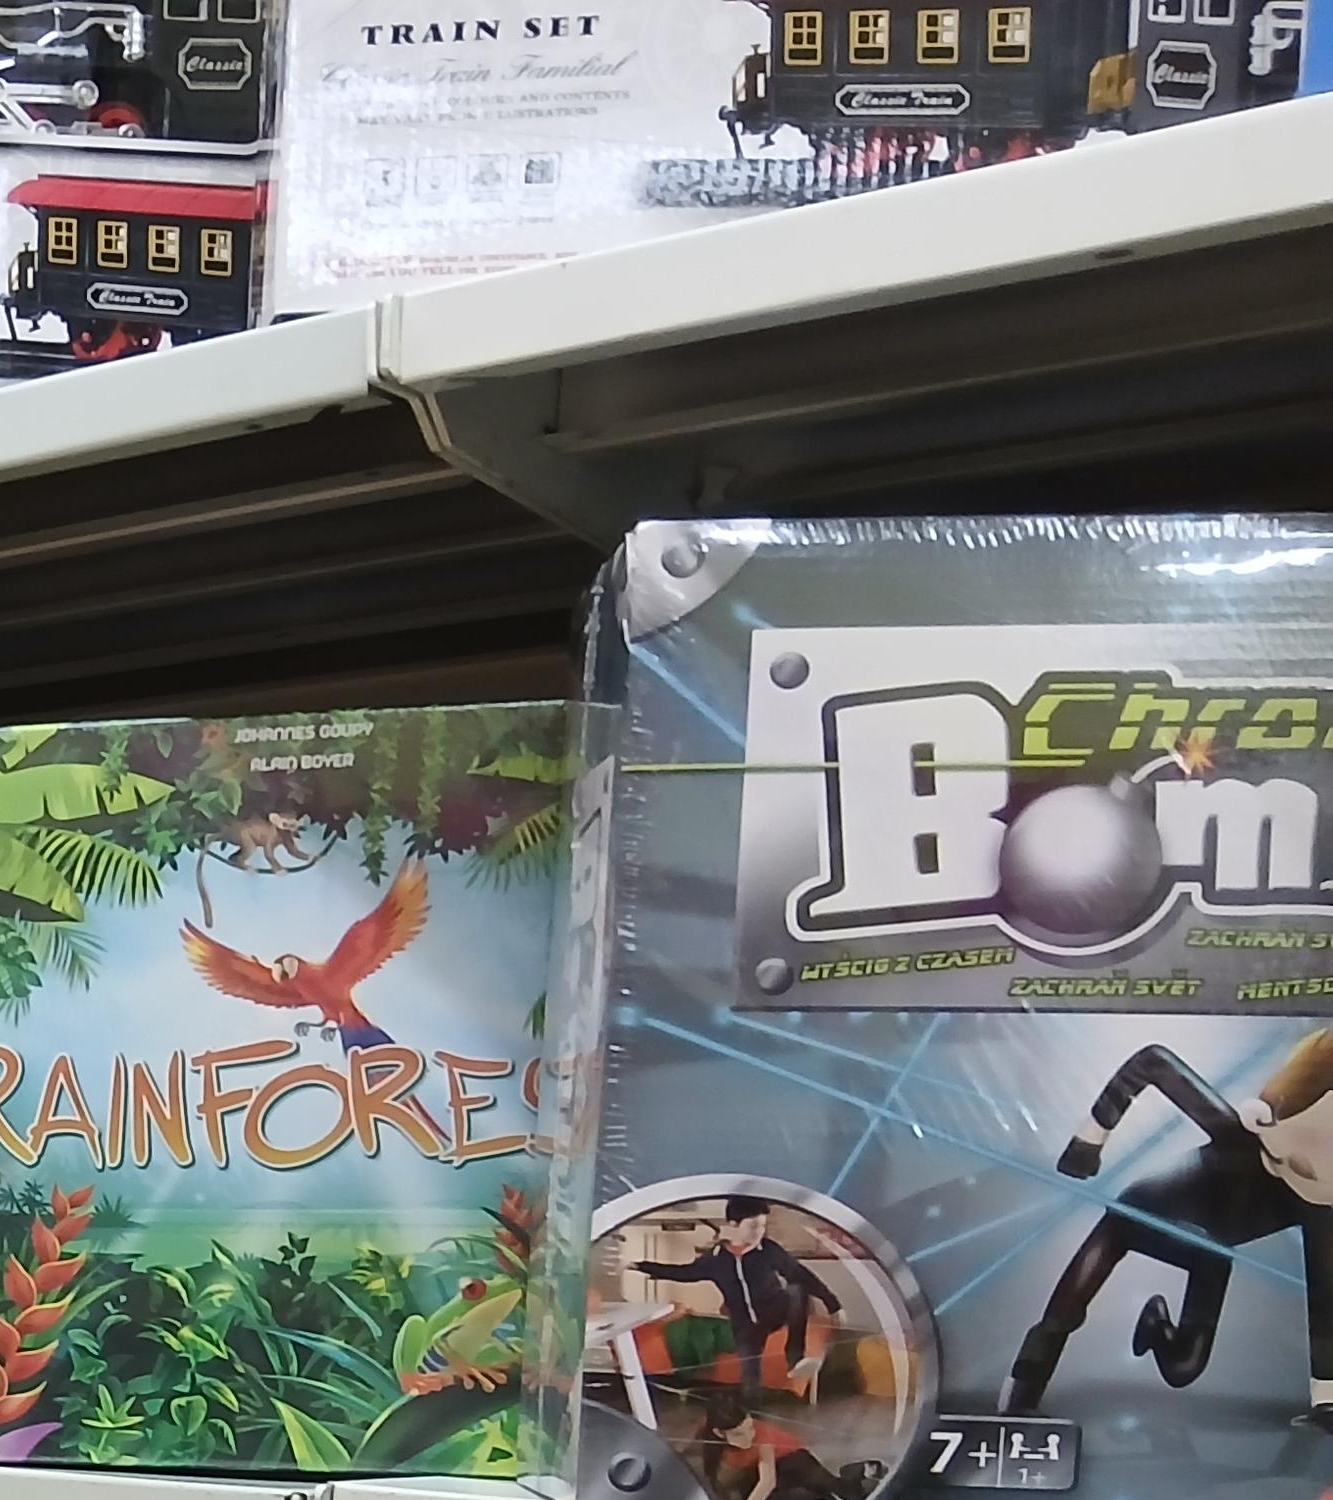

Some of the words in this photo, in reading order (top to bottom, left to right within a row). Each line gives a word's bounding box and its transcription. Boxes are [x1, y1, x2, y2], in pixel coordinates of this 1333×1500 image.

[361, 20, 501, 45] TRAIN
[523, 15, 600, 39] SET
[234, 723, 315, 743] JOHANNES
[318, 720, 374, 740] GOUPY
[250, 753, 298, 773] ALAIN
[301, 751, 355, 770] BOYER
[915, 945, 1015, 974] CZASEM
[1133, 969, 1204, 998] SVĚT
[930, 1431, 997, 1475] 7+
